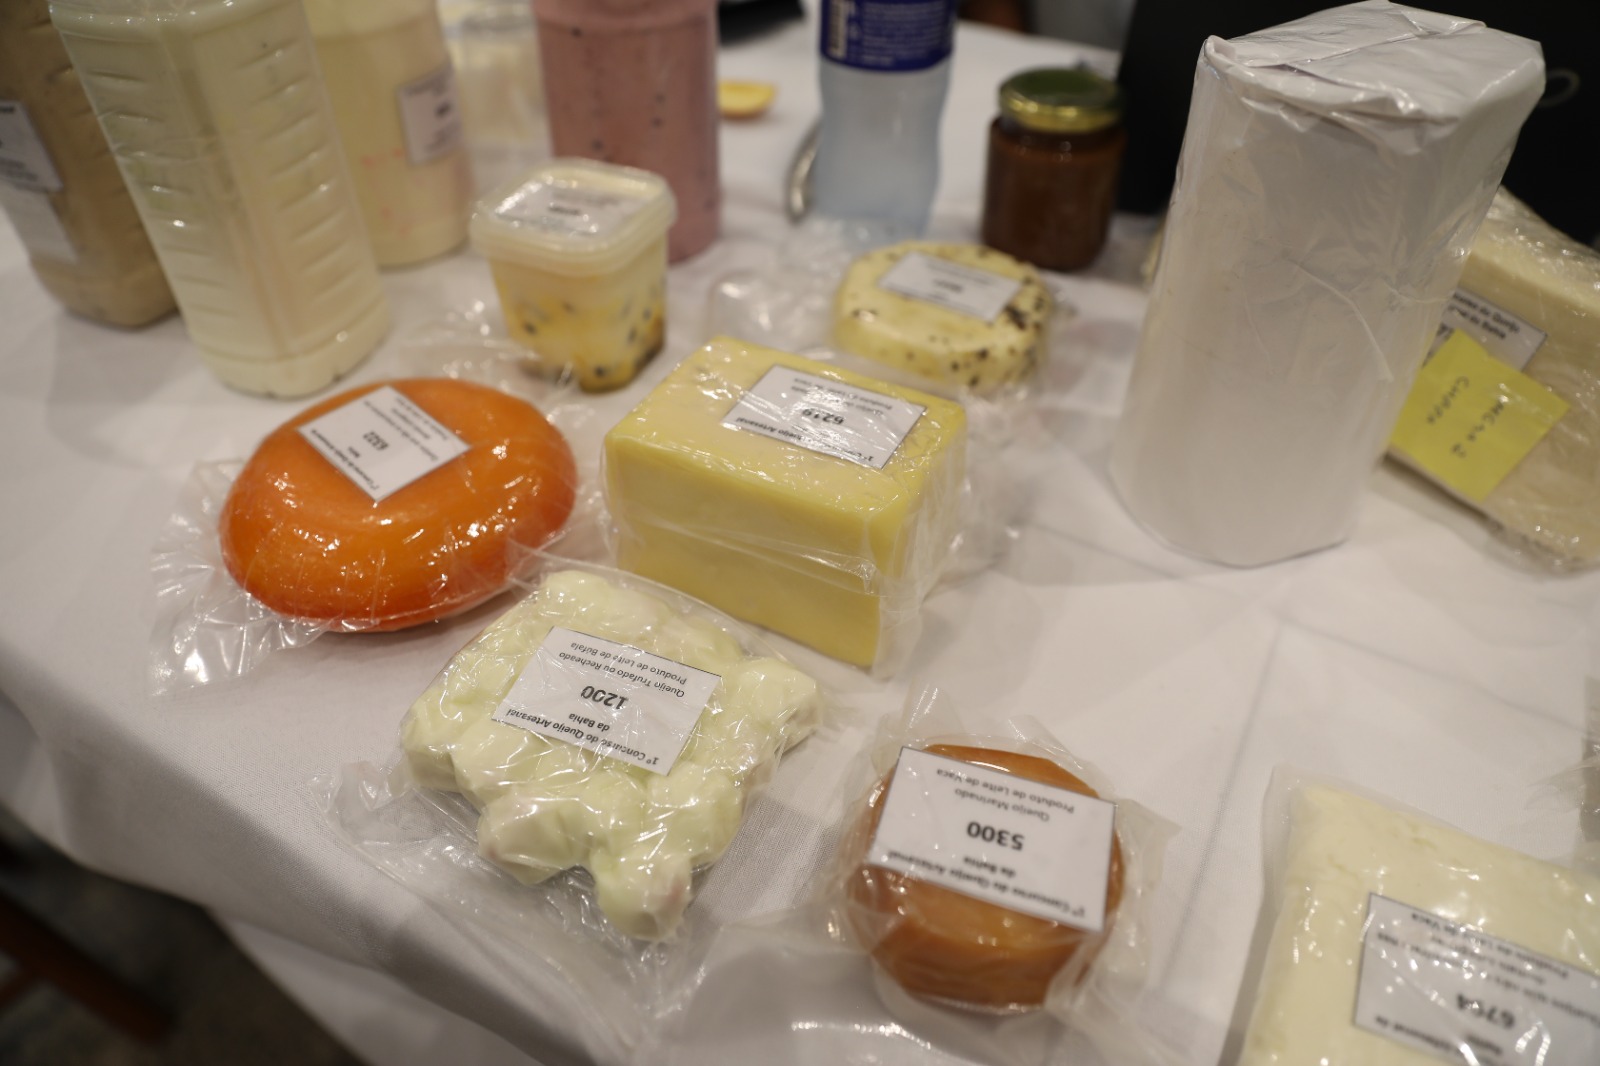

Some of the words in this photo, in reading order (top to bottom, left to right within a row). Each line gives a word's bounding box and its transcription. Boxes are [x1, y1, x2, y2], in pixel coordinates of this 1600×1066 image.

[569, 642, 598, 655] Búfala
[598, 650, 612, 659] de
[557, 652, 601, 669] Recheado
[634, 662, 649, 671] de
[602, 664, 616, 673] ou
[648, 667, 687, 683] Produto
[615, 670, 652, 685] Trufado
[579, 685, 628, 709] 1200
[652, 682, 685, 697] Queijo
[506, 708, 551, 727] Artesanal
[567, 713, 595, 726] Bahia
[551, 721, 585, 738] Queijo
[595, 722, 610, 732] da
[583, 733, 599, 744] do
[598, 739, 645, 759] Concurso
[936, 768, 962, 781] Vaca
[964, 775, 979, 787] de
[982, 781, 1008, 794] Leite
[1012, 788, 1026, 800] de
[954, 788, 1007, 809] Marinado
[1029, 793, 1073, 812] Produto
[1011, 803, 1049, 821] Queijo
[965, 820, 1024, 851] 5300
[887, 850, 945, 874] Artesanal
[963, 856, 996, 872] Bahia
[949, 867, 989, 888] Queijo
[999, 866, 1016, 879] da
[991, 880, 1009, 895] do
[1012, 887, 1068, 912] Concurso
